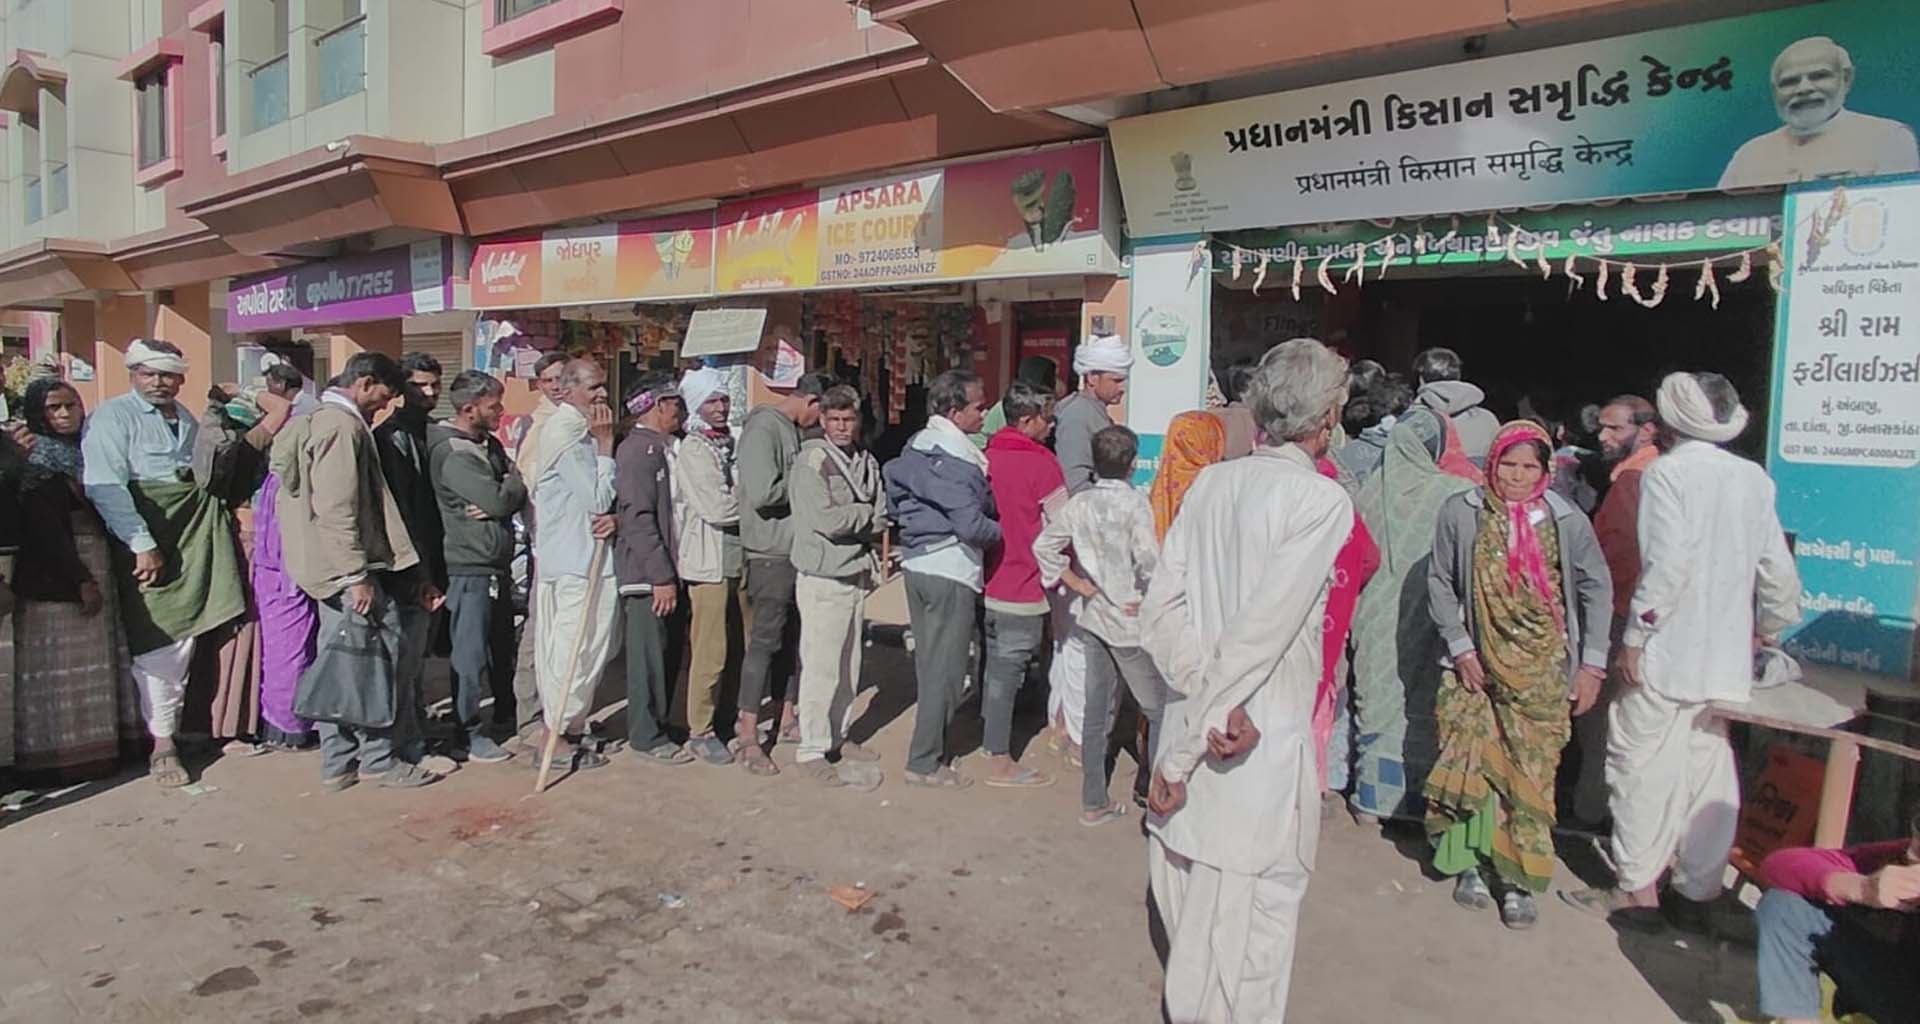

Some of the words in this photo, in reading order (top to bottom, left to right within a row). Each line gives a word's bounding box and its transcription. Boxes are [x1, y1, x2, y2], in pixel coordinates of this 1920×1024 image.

[1224, 98, 1371, 153] પ્રધાનમંત્રી
[1384, 92, 1493, 132] કિસાન
[1509, 63, 1630, 121] સમૃદ્ધિ
[1641, 55, 1733, 97] કેન્દ્ર
[1296, 160, 1391, 194] प्रधानमंत्री
[1399, 155, 1476, 183] किसान
[1486, 140, 1564, 181] समृद्धि
[1573, 135, 1634, 167] केन्द्र
[835, 181, 922, 214] APSARA
[827, 222, 856, 246] ICE
[861, 212, 932, 242] COURT
[1619, 221, 1696, 244] નાશક
[1818, 308, 1848, 337] શ્રી
[1859, 315, 1901, 337] રામ
